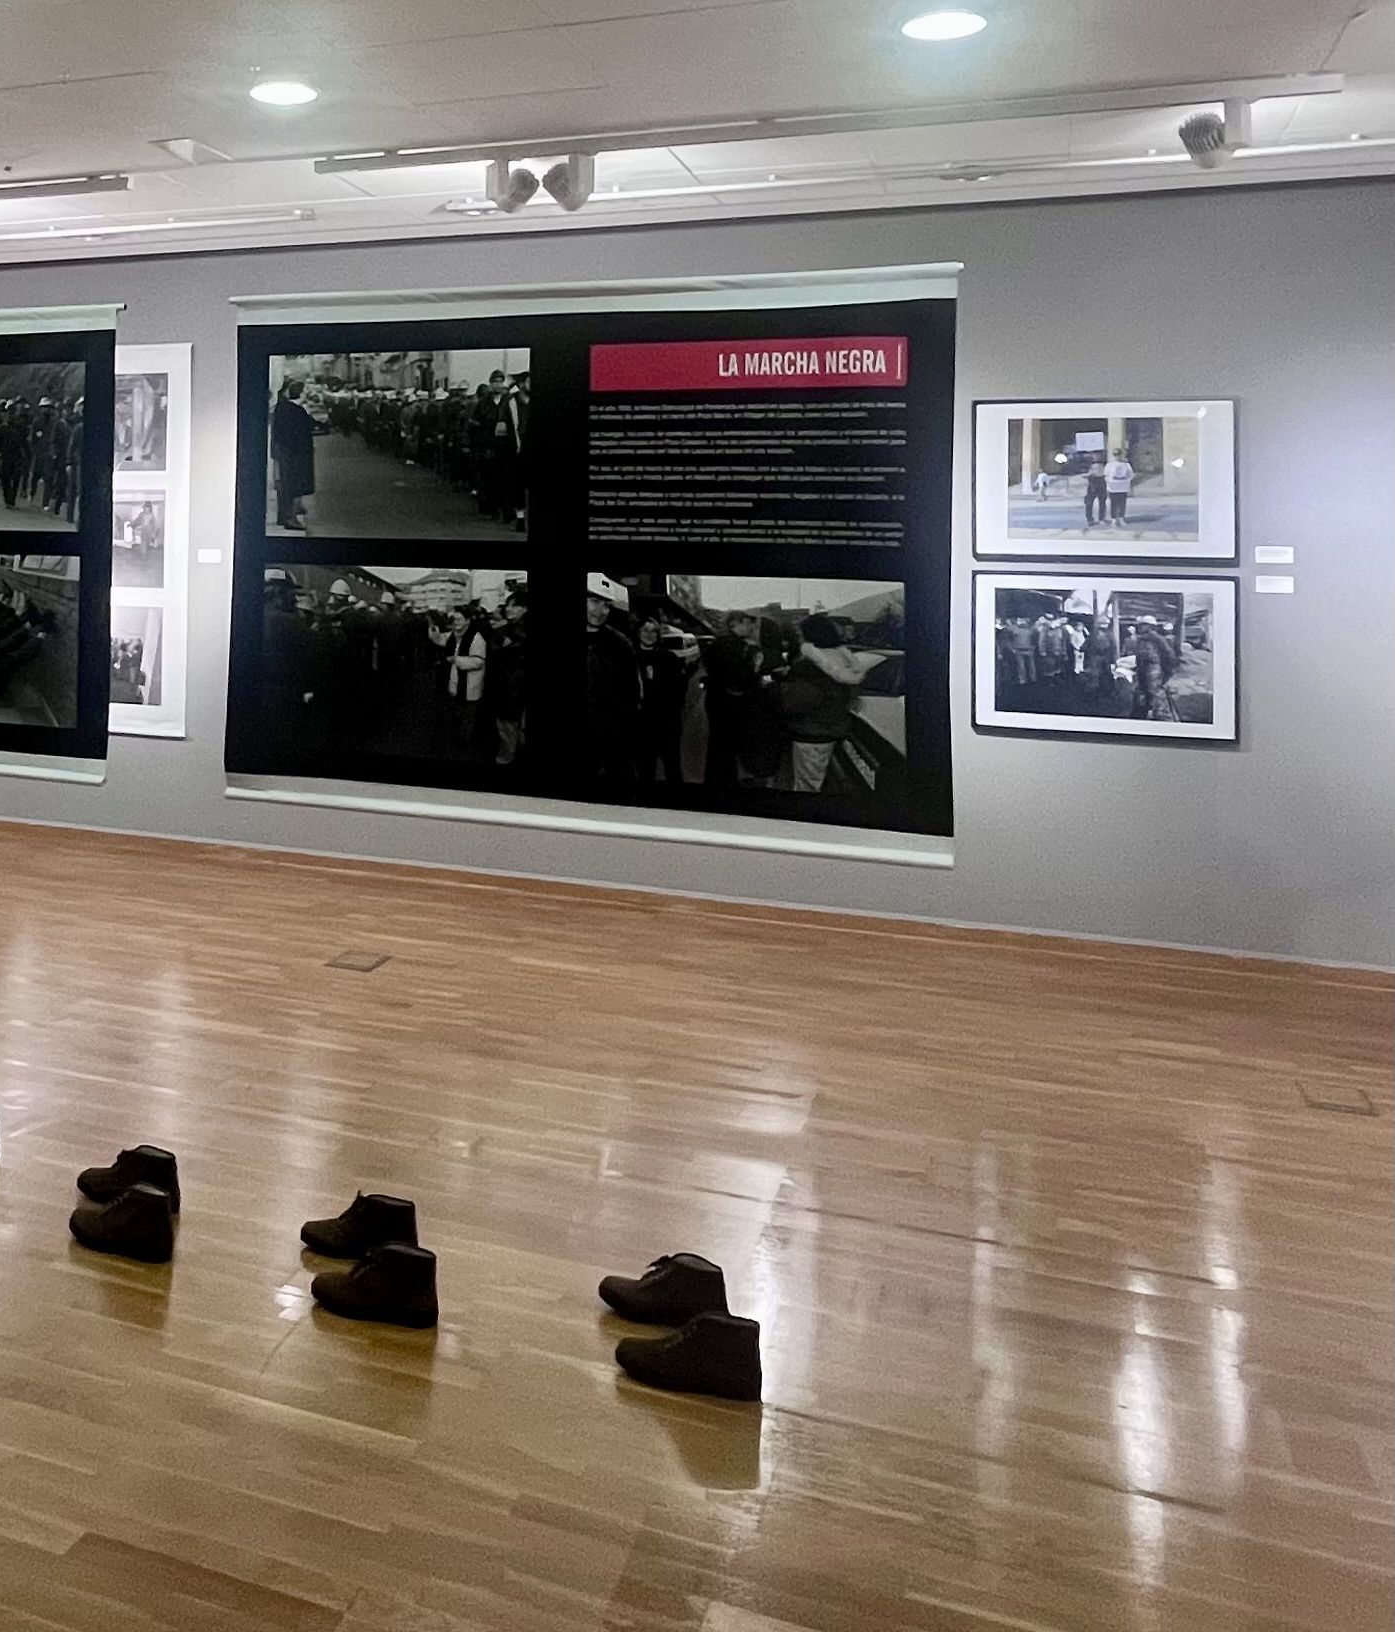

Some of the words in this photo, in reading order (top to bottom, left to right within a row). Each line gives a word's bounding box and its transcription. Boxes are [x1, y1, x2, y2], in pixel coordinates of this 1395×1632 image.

[718, 353, 739, 377] LA
[744, 351, 819, 376] MARCHA
[825, 349, 886, 374] NEGRA
